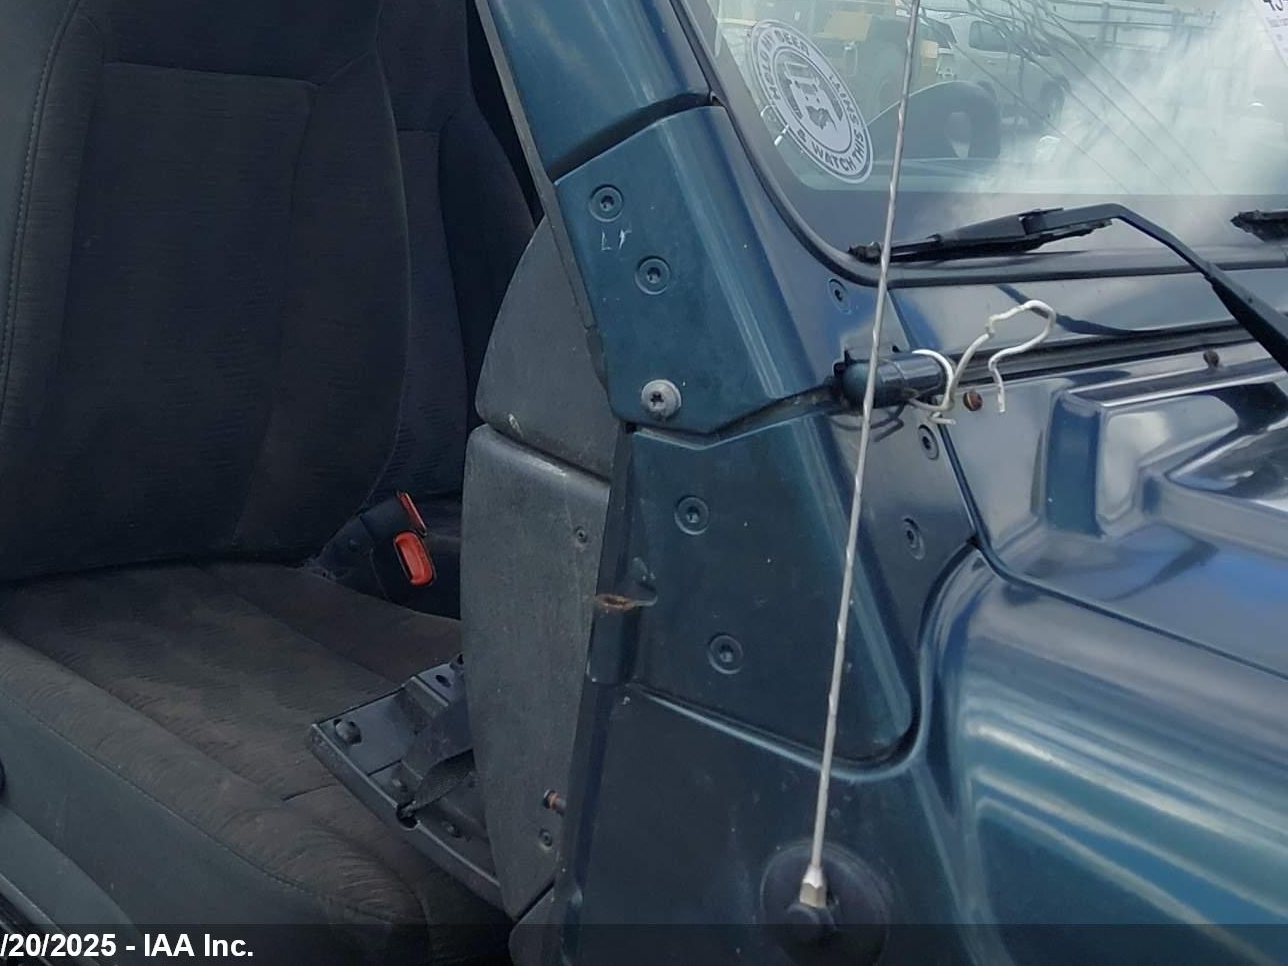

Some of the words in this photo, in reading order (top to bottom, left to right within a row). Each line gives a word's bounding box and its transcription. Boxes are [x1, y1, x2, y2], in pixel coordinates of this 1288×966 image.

[759, 49, 781, 101] HOLD
[774, 29, 810, 57] BEER
[797, 128, 807, 143] &
[812, 140, 857, 172] WATCH
[852, 128, 865, 164] THIS
